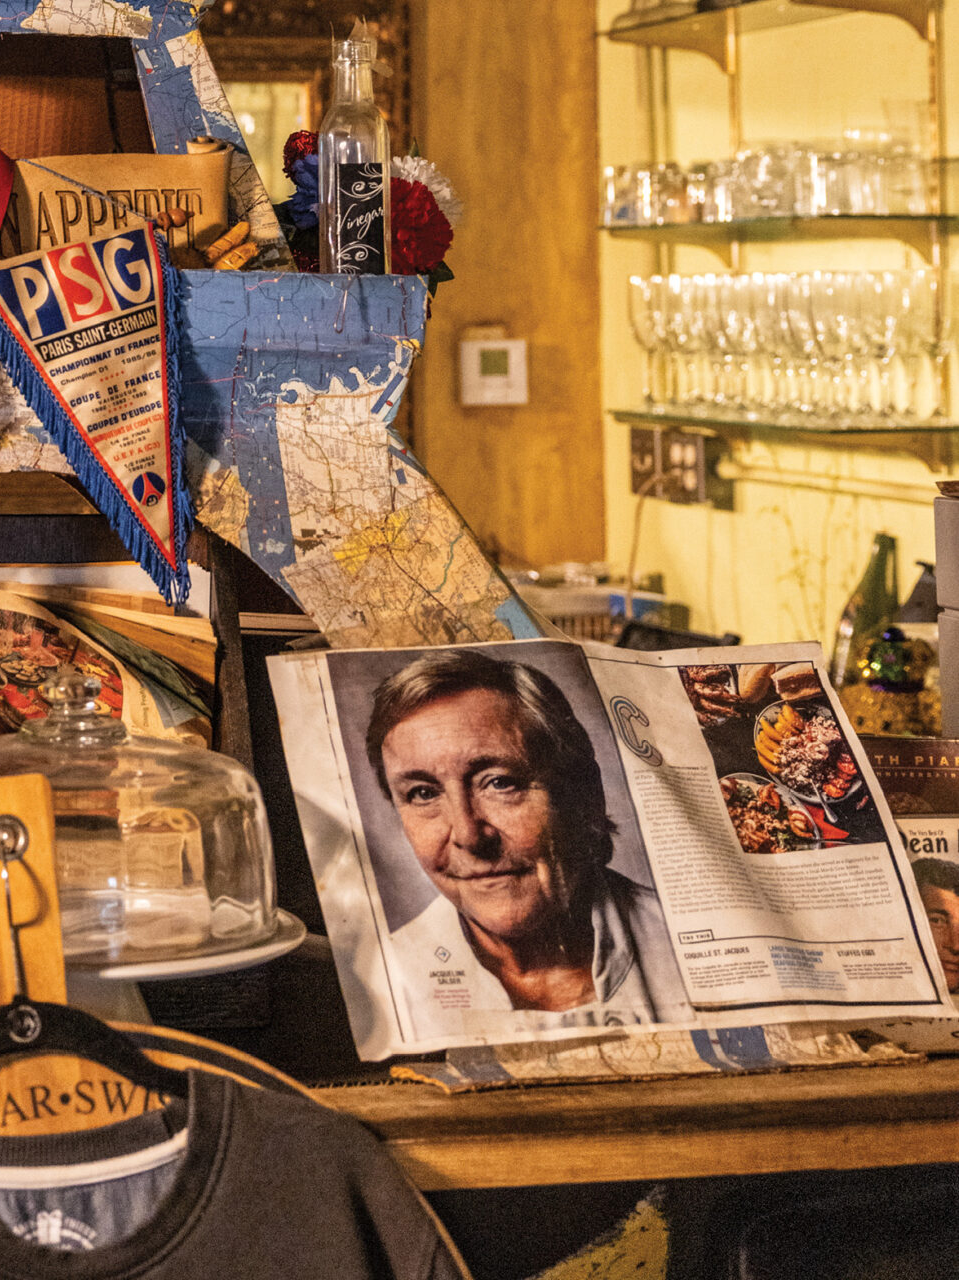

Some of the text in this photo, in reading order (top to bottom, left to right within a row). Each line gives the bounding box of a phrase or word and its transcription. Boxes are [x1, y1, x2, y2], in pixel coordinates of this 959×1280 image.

[10, 237, 152, 340] PSG
[41, 309, 157, 361] PARIS SAINT-GERMAIN
[49, 334, 161, 377] CHAMPIONNAT DE FRANCE
[70, 370, 161, 408] COUPE DE FRANCE
[87, 400, 162, 433] COUPES D'EUROPE
